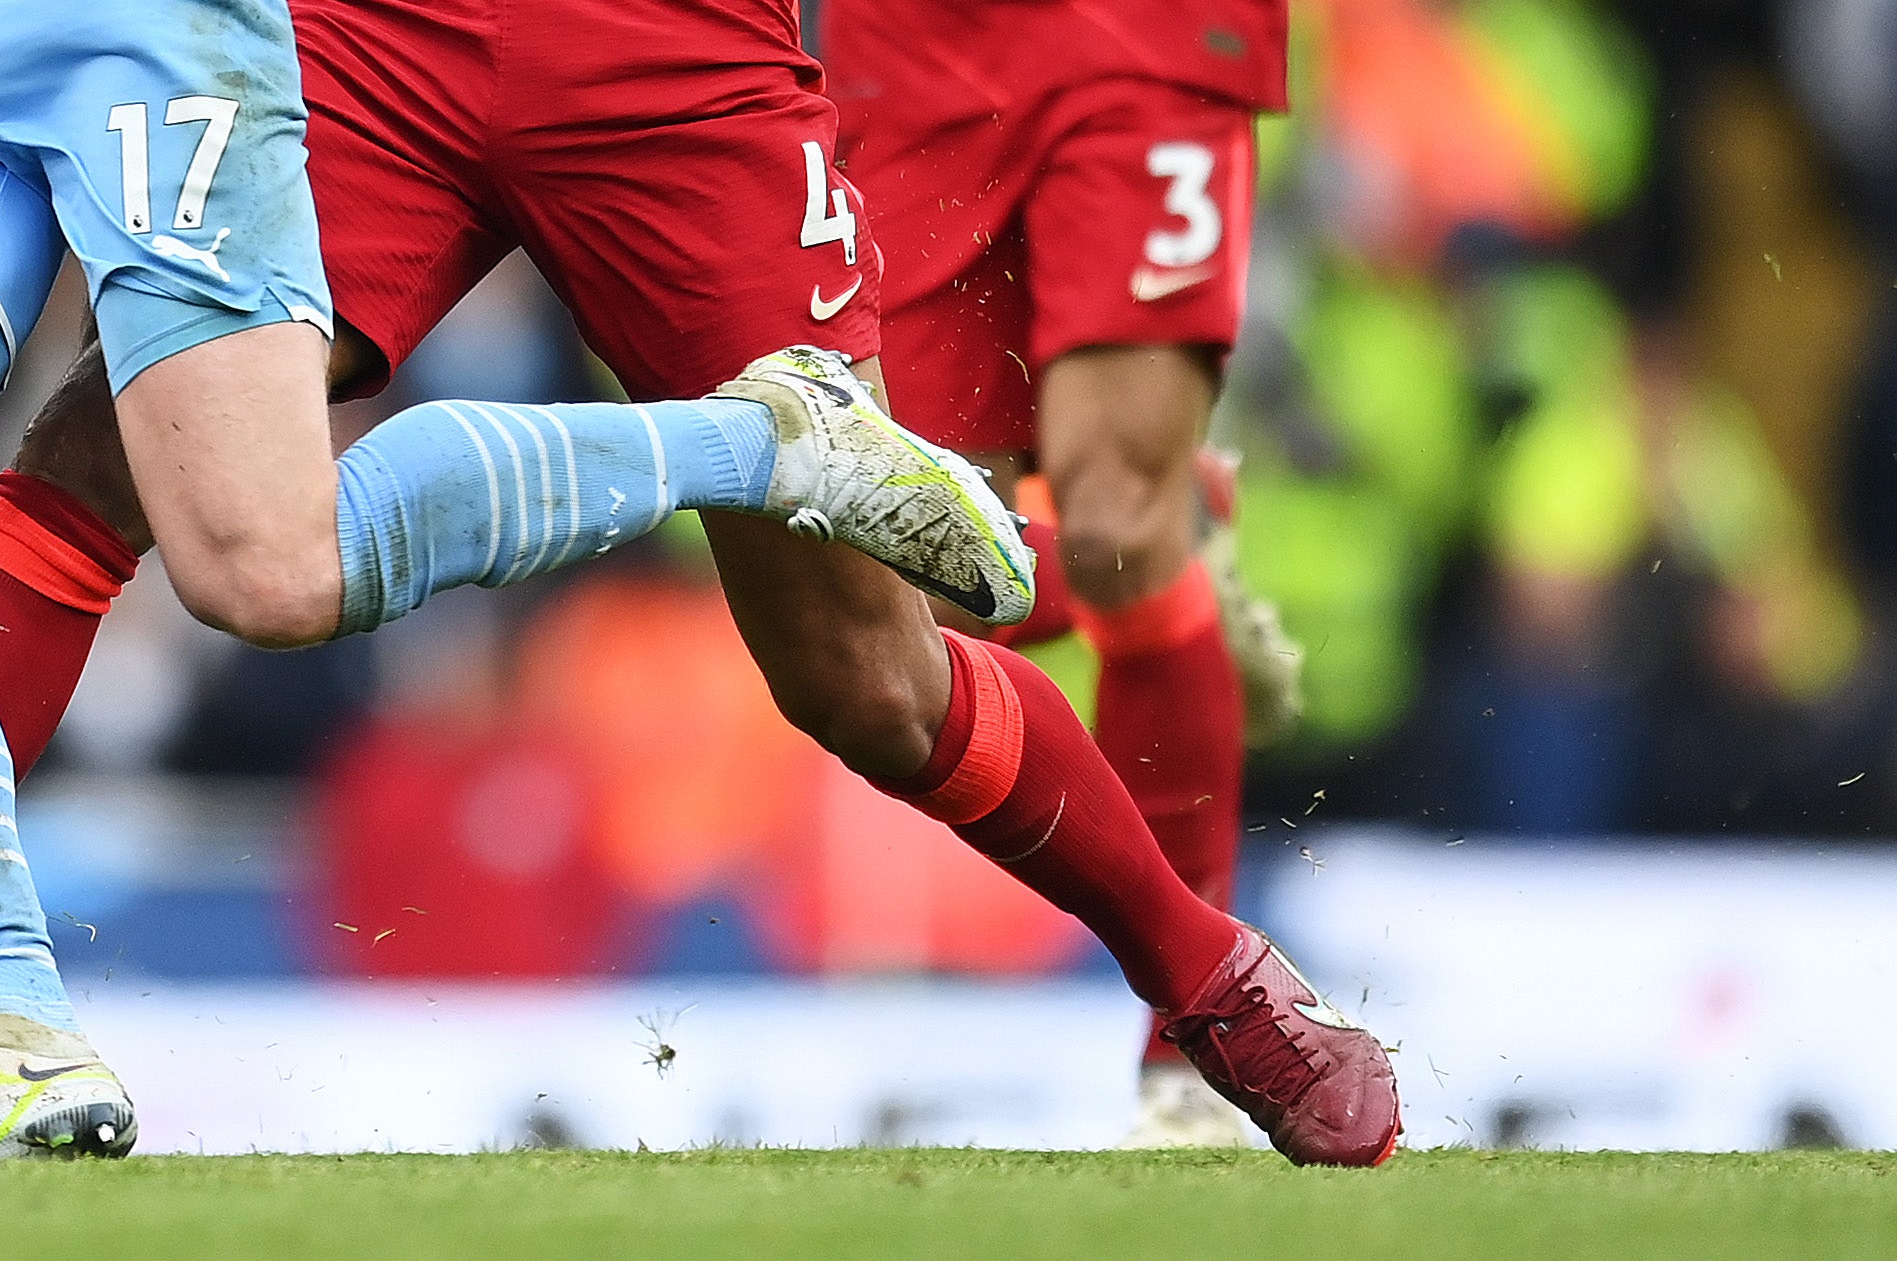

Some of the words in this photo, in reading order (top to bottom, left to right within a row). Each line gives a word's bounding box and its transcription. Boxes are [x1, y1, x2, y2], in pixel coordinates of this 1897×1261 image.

[105, 94, 241, 235] 17
[800, 140, 858, 266] 4
[1145, 142, 1222, 267] 3
